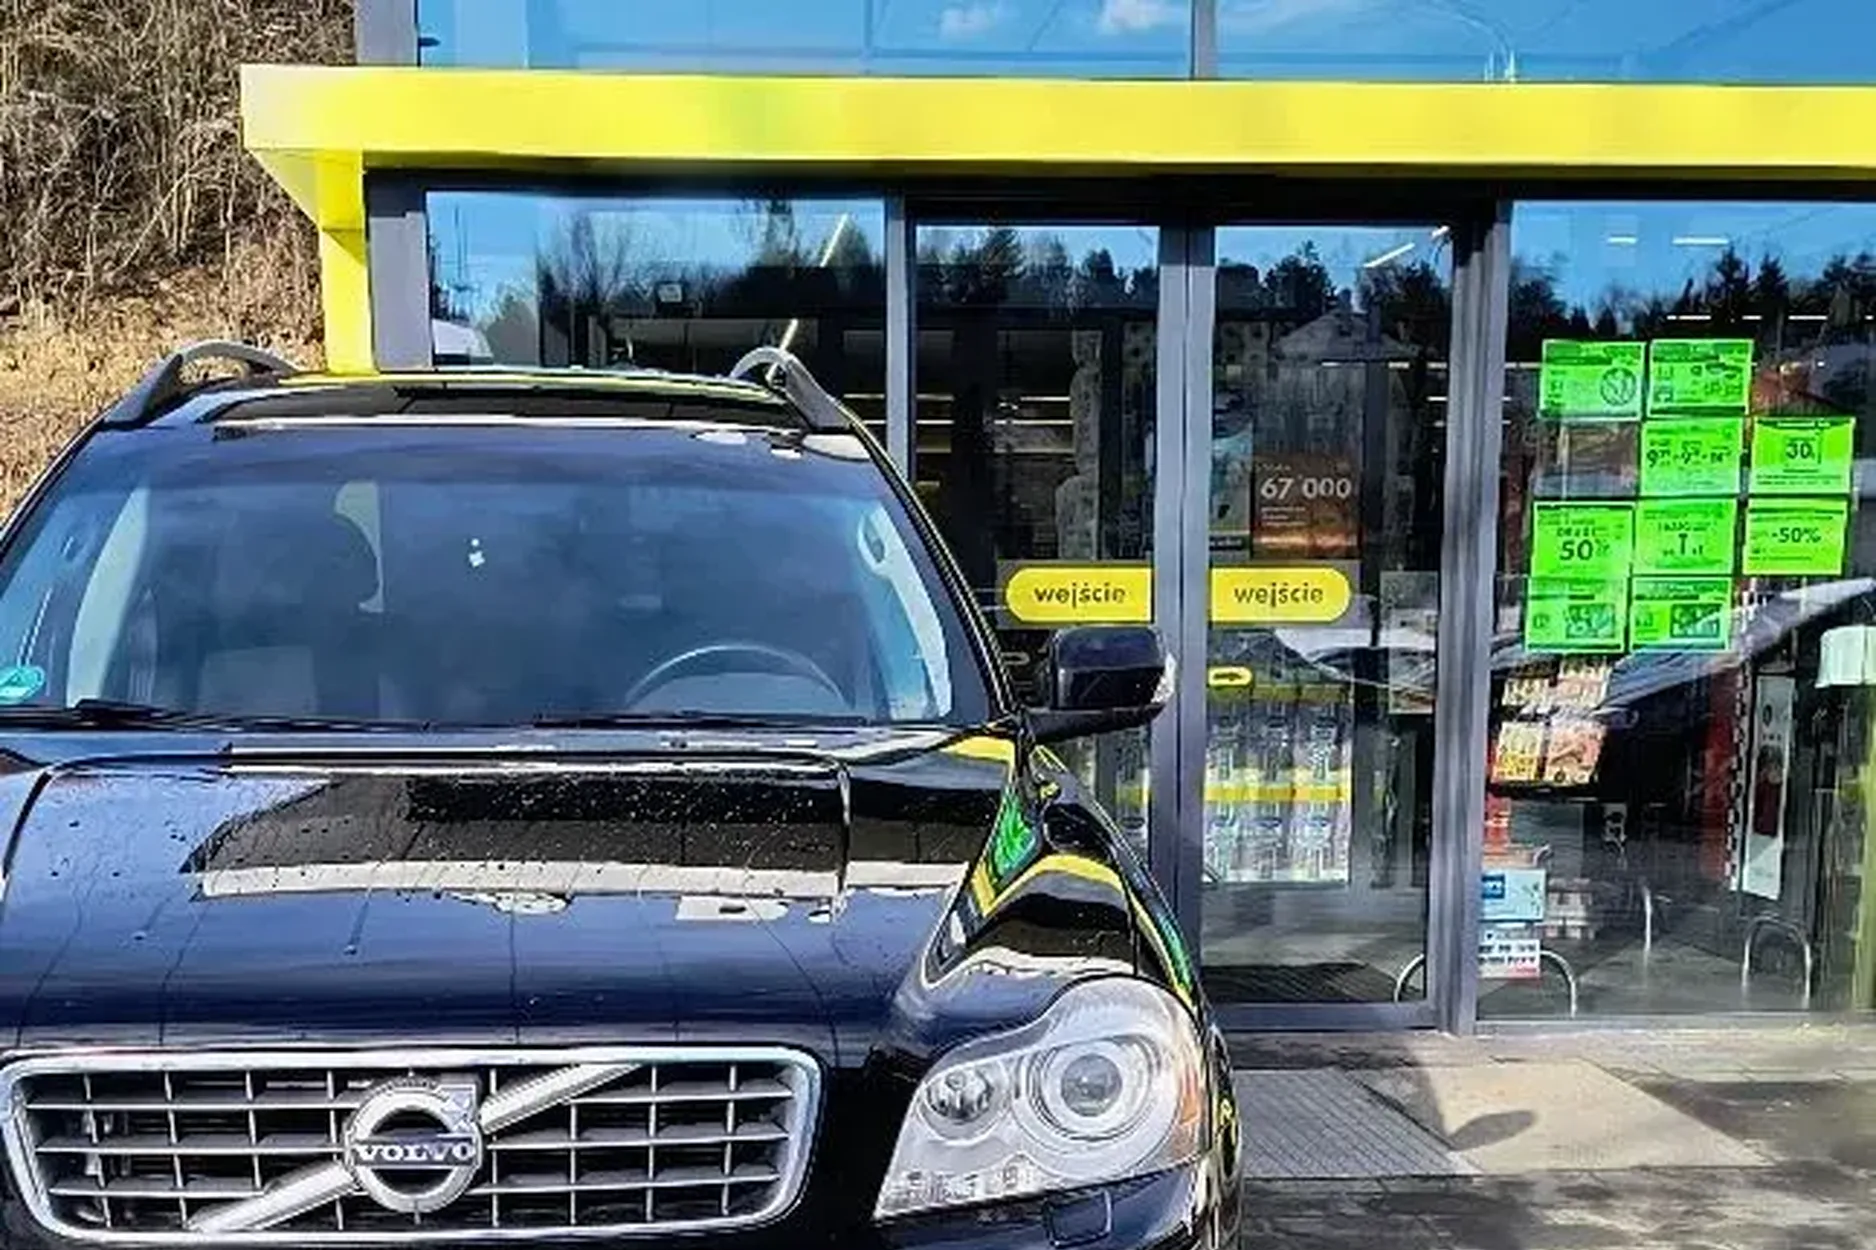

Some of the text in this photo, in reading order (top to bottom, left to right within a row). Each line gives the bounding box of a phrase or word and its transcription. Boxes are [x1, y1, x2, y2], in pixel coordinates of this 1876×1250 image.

[1260, 477, 1352, 499] 67 000
[1033, 581, 1126, 608] wejście
[1233, 581, 1324, 608] wejście
[353, 1142, 477, 1161] VOLVO
